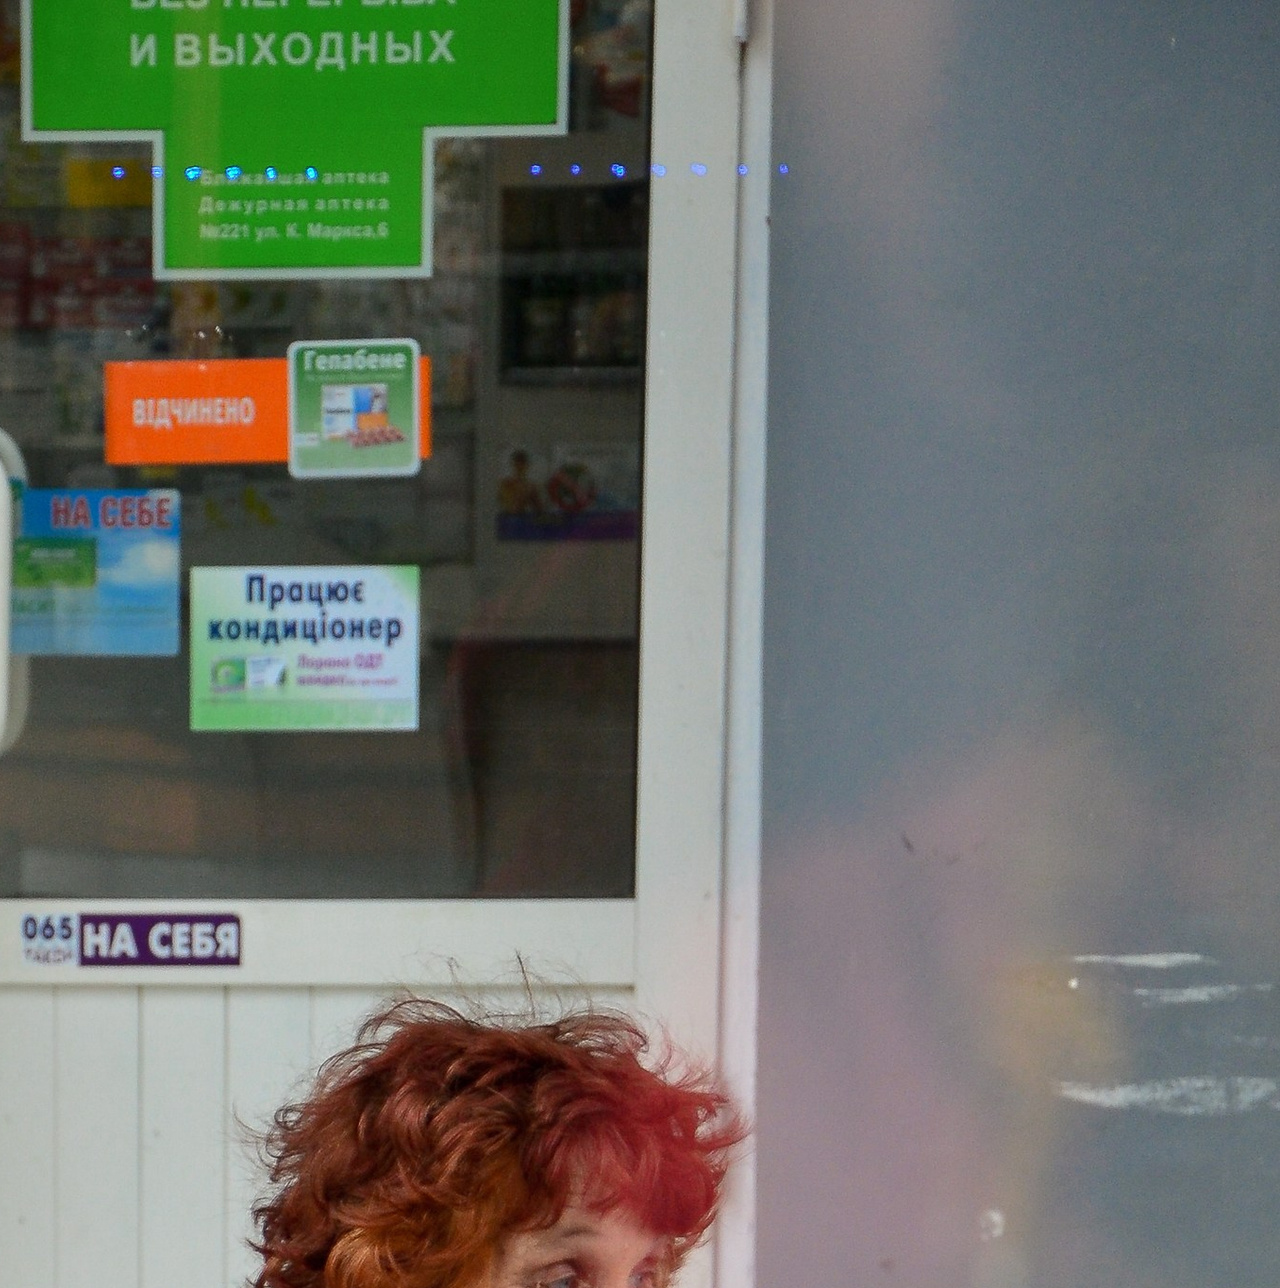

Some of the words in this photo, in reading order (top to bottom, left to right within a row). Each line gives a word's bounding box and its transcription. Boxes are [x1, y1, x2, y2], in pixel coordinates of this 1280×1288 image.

[129, 33, 157, 67] И
[174, 29, 457, 71] ВЫХОДНЫХ
[303, 349, 408, 371] Гепабене
[132, 397, 256, 431] ВІДЧИНЕНО
[51, 495, 91, 529] НА
[99, 495, 172, 529] СЕБЕ
[246, 573, 365, 611] Працює
[208, 611, 403, 648] кондиціонер
[24, 916, 72, 940] 065
[83, 922, 138, 959] НА
[148, 921, 239, 960] СЕБЯ
